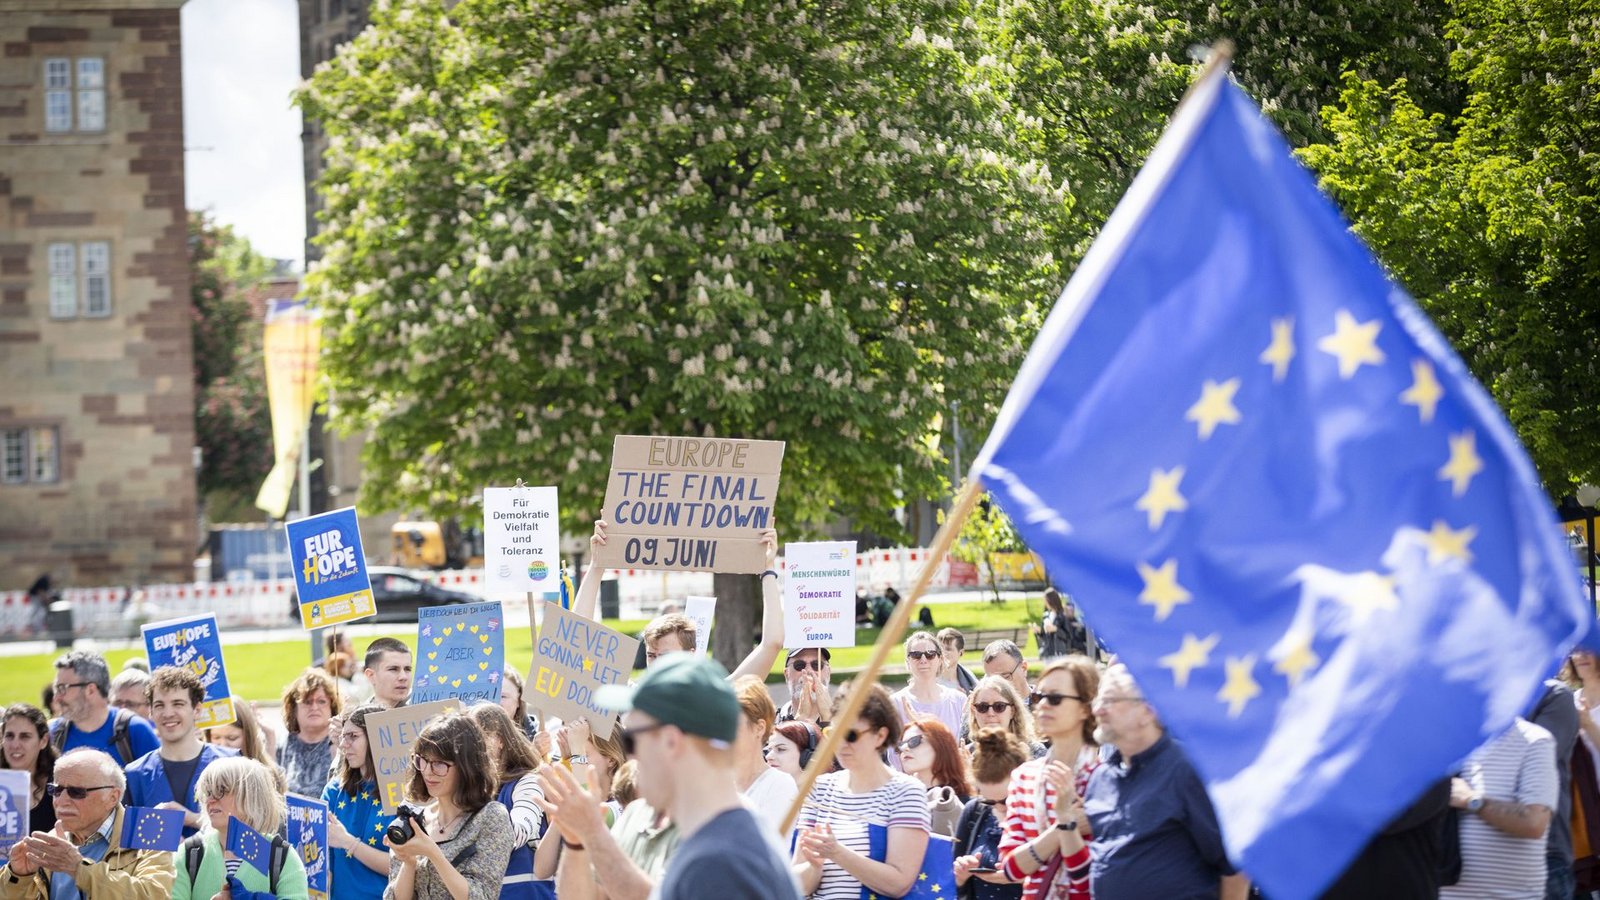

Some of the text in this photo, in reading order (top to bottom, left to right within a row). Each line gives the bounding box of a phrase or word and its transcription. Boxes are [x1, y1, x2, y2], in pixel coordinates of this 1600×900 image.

[648, 438, 749, 468] EUROPE
[618, 472, 765, 501] THE FINAL
[513, 498, 529, 508] Für
[493, 510, 550, 520] Demokratie
[614, 500, 770, 529] COUNTDOWN
[504, 522, 539, 532] Vielfalt
[304, 529, 344, 560] EUR
[512, 535, 532, 544] und
[501, 547, 543, 556] Toleranz
[625, 537, 717, 568] 09. JUNI
[303, 546, 357, 585] HOPE
[792, 568, 850, 578] MENSCHENWÜRDE
[799, 590, 842, 599] DEMOKRATIE
[799, 609, 840, 620] SOLIDARITÄT
[153, 623, 211, 652] EURHOPE
[556, 616, 619, 663] NEVER
[806, 632, 833, 641] EUROPA
[174, 644, 197, 668] CAN
[445, 647, 474, 661] ABER
[538, 637, 622, 685] GONNA LET
[535, 665, 564, 698] EU
[291, 806, 323, 825] EURHOPE
[301, 826, 315, 844] CAN
[304, 840, 319, 864] EU
